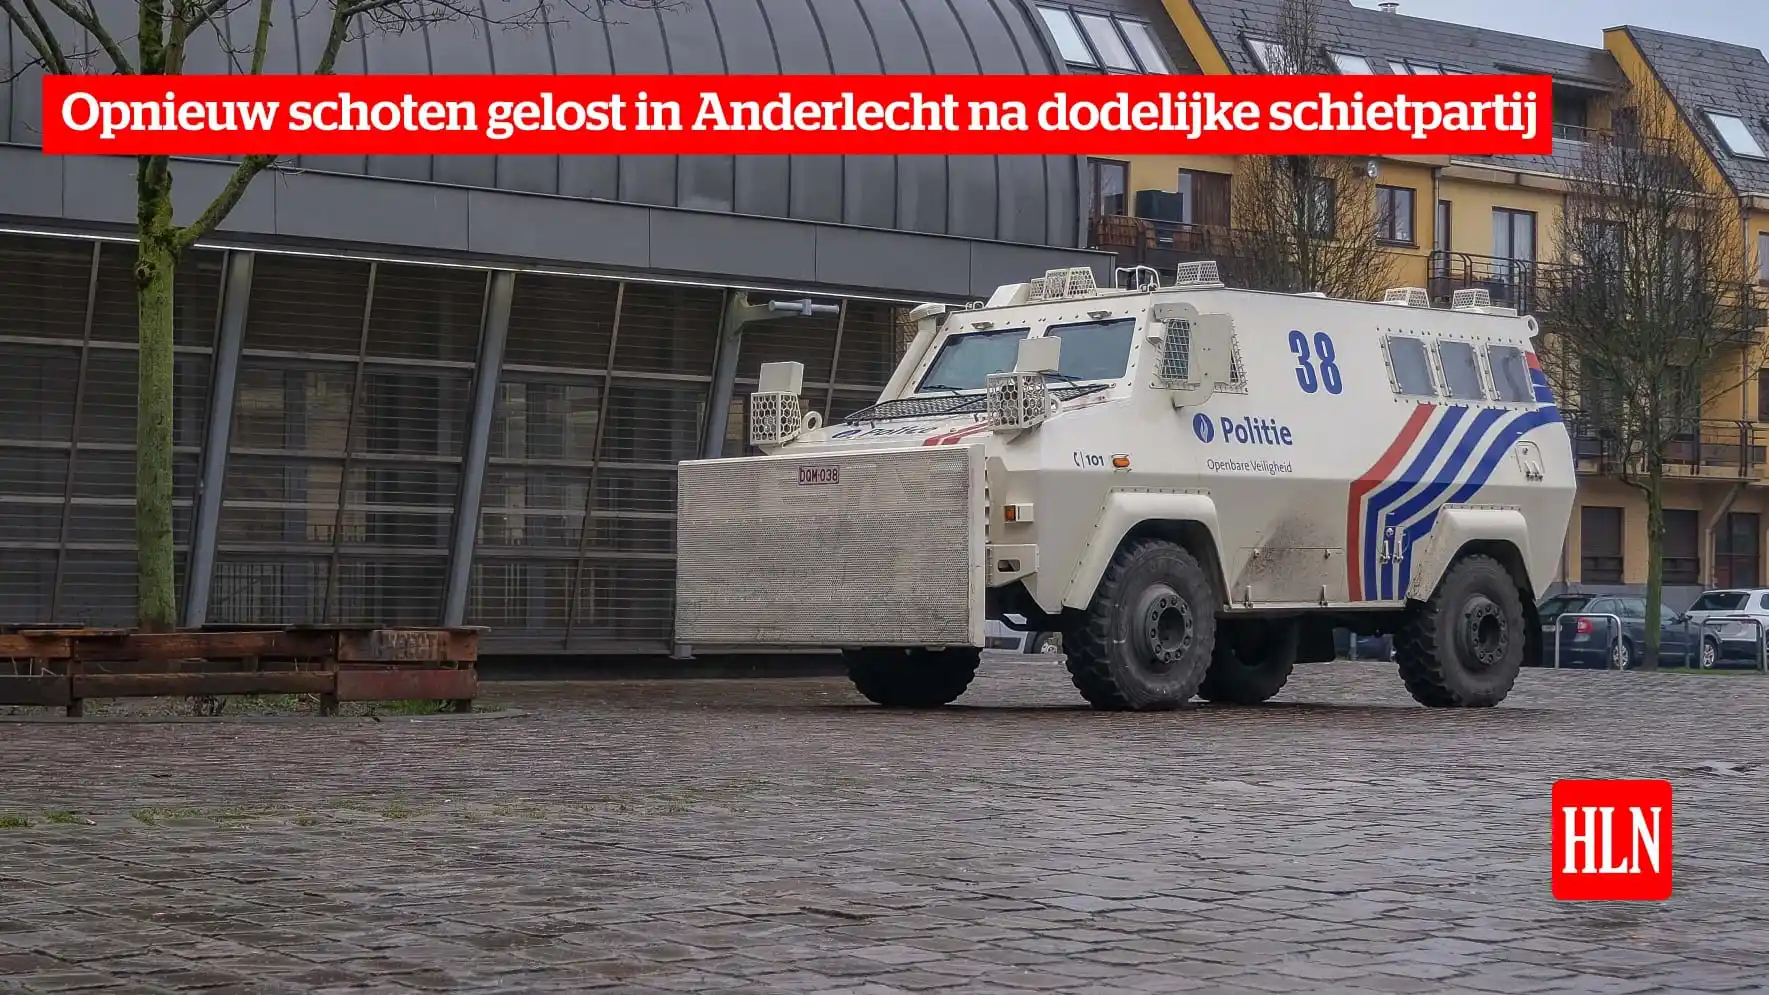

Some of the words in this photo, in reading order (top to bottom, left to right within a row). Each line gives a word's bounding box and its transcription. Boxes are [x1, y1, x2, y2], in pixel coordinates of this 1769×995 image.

[1288, 330, 1343, 395] 38
[1220, 416, 1293, 445] Politie
[1085, 454, 1105, 467] 101
[1207, 459, 1250, 472] Openbare
[1250, 460, 1293, 475] Veiligheid
